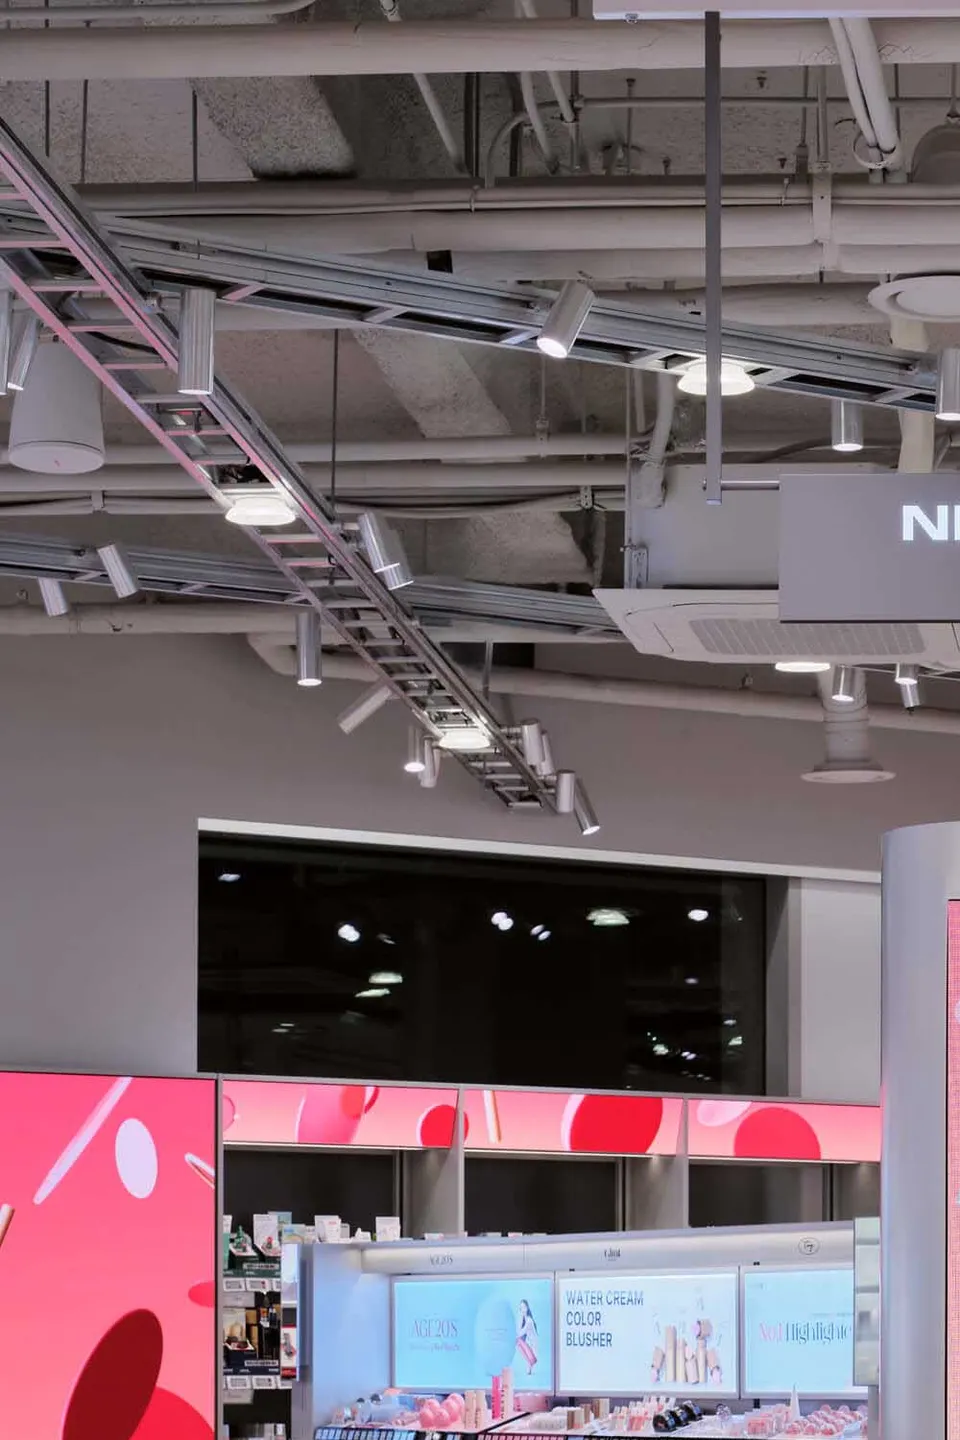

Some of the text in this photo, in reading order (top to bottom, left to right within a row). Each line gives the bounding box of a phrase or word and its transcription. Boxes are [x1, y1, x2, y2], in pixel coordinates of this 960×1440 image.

[566, 1290, 644, 1306] WATER CREAM
[566, 1311, 602, 1326] COLOR
[566, 1332, 613, 1347] BLUSHER
